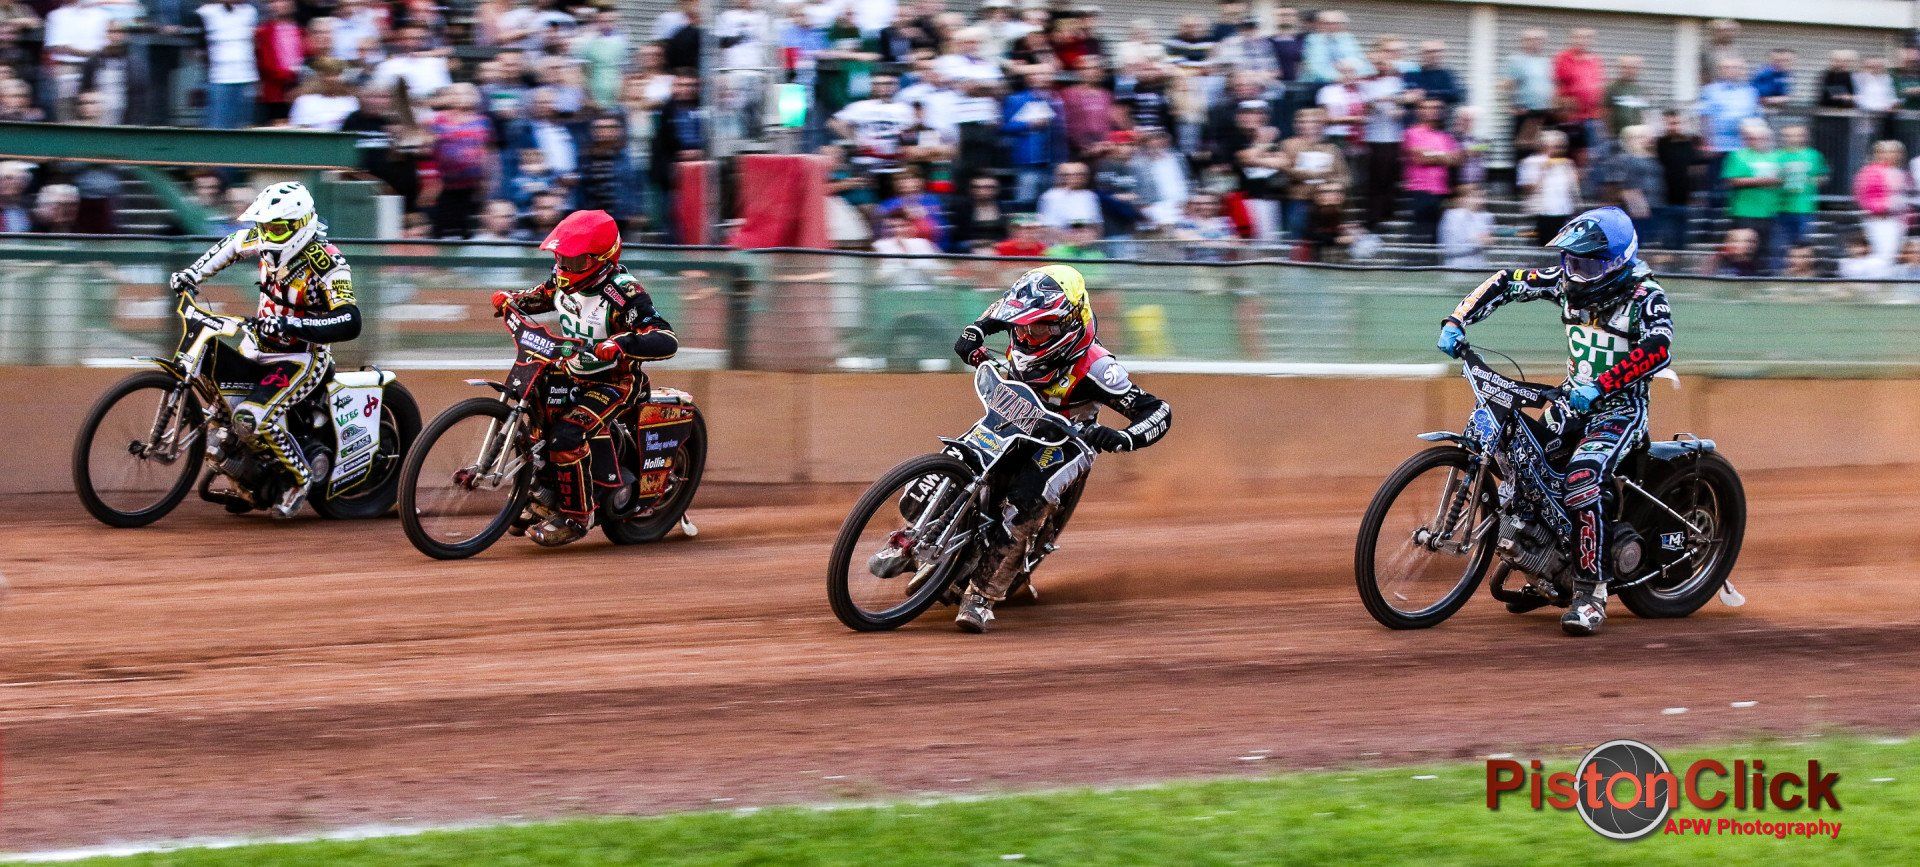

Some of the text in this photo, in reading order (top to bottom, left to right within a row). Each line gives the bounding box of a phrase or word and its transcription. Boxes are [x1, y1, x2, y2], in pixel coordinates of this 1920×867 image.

[308, 244, 331, 270] DAD
[521, 330, 556, 351] MORRIS
[1471, 365, 1493, 382] Grant
[1491, 373, 1538, 402] Henderson
[1481, 381, 1514, 403] Tankers
[643, 457, 666, 470] Hollie
[909, 473, 943, 503] LAW
